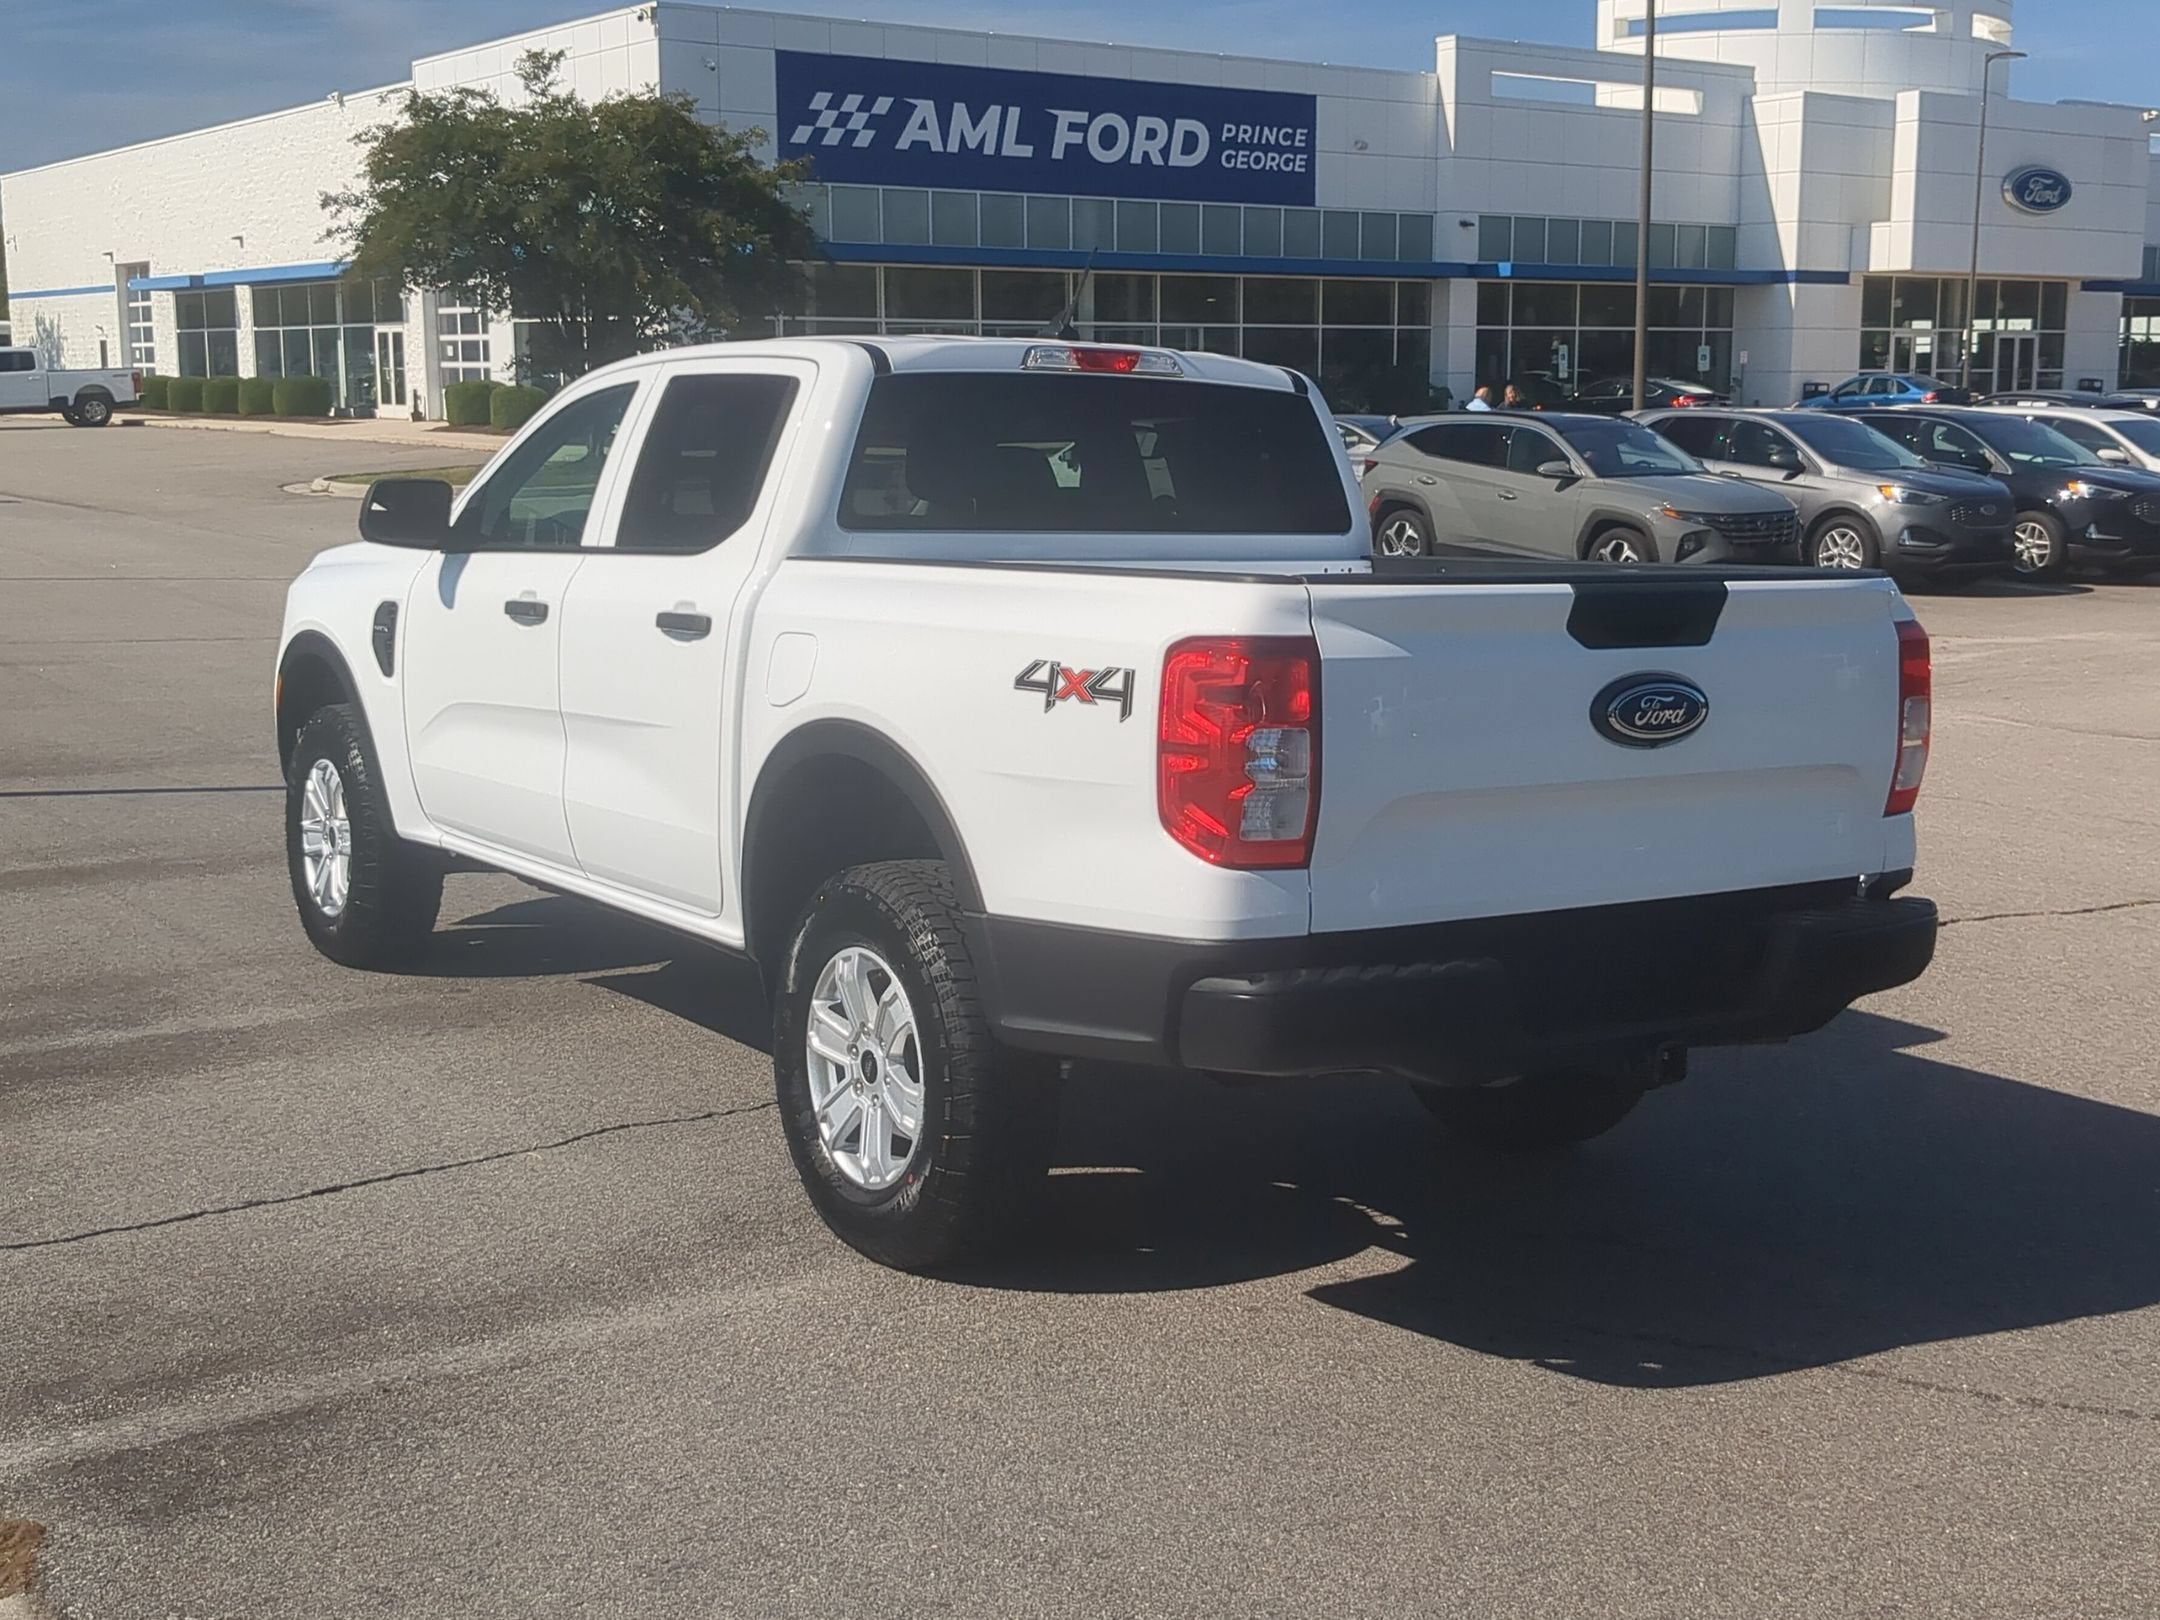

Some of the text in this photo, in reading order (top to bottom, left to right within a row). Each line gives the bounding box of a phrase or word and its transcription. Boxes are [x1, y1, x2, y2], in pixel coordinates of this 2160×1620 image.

[895, 98, 1210, 168] AML FORD
[1221, 123, 1309, 147] PRINCE
[1220, 149, 1308, 173] GEORGE
[2024, 176, 2063, 204] Ford
[1634, 695, 1688, 726] Ford
